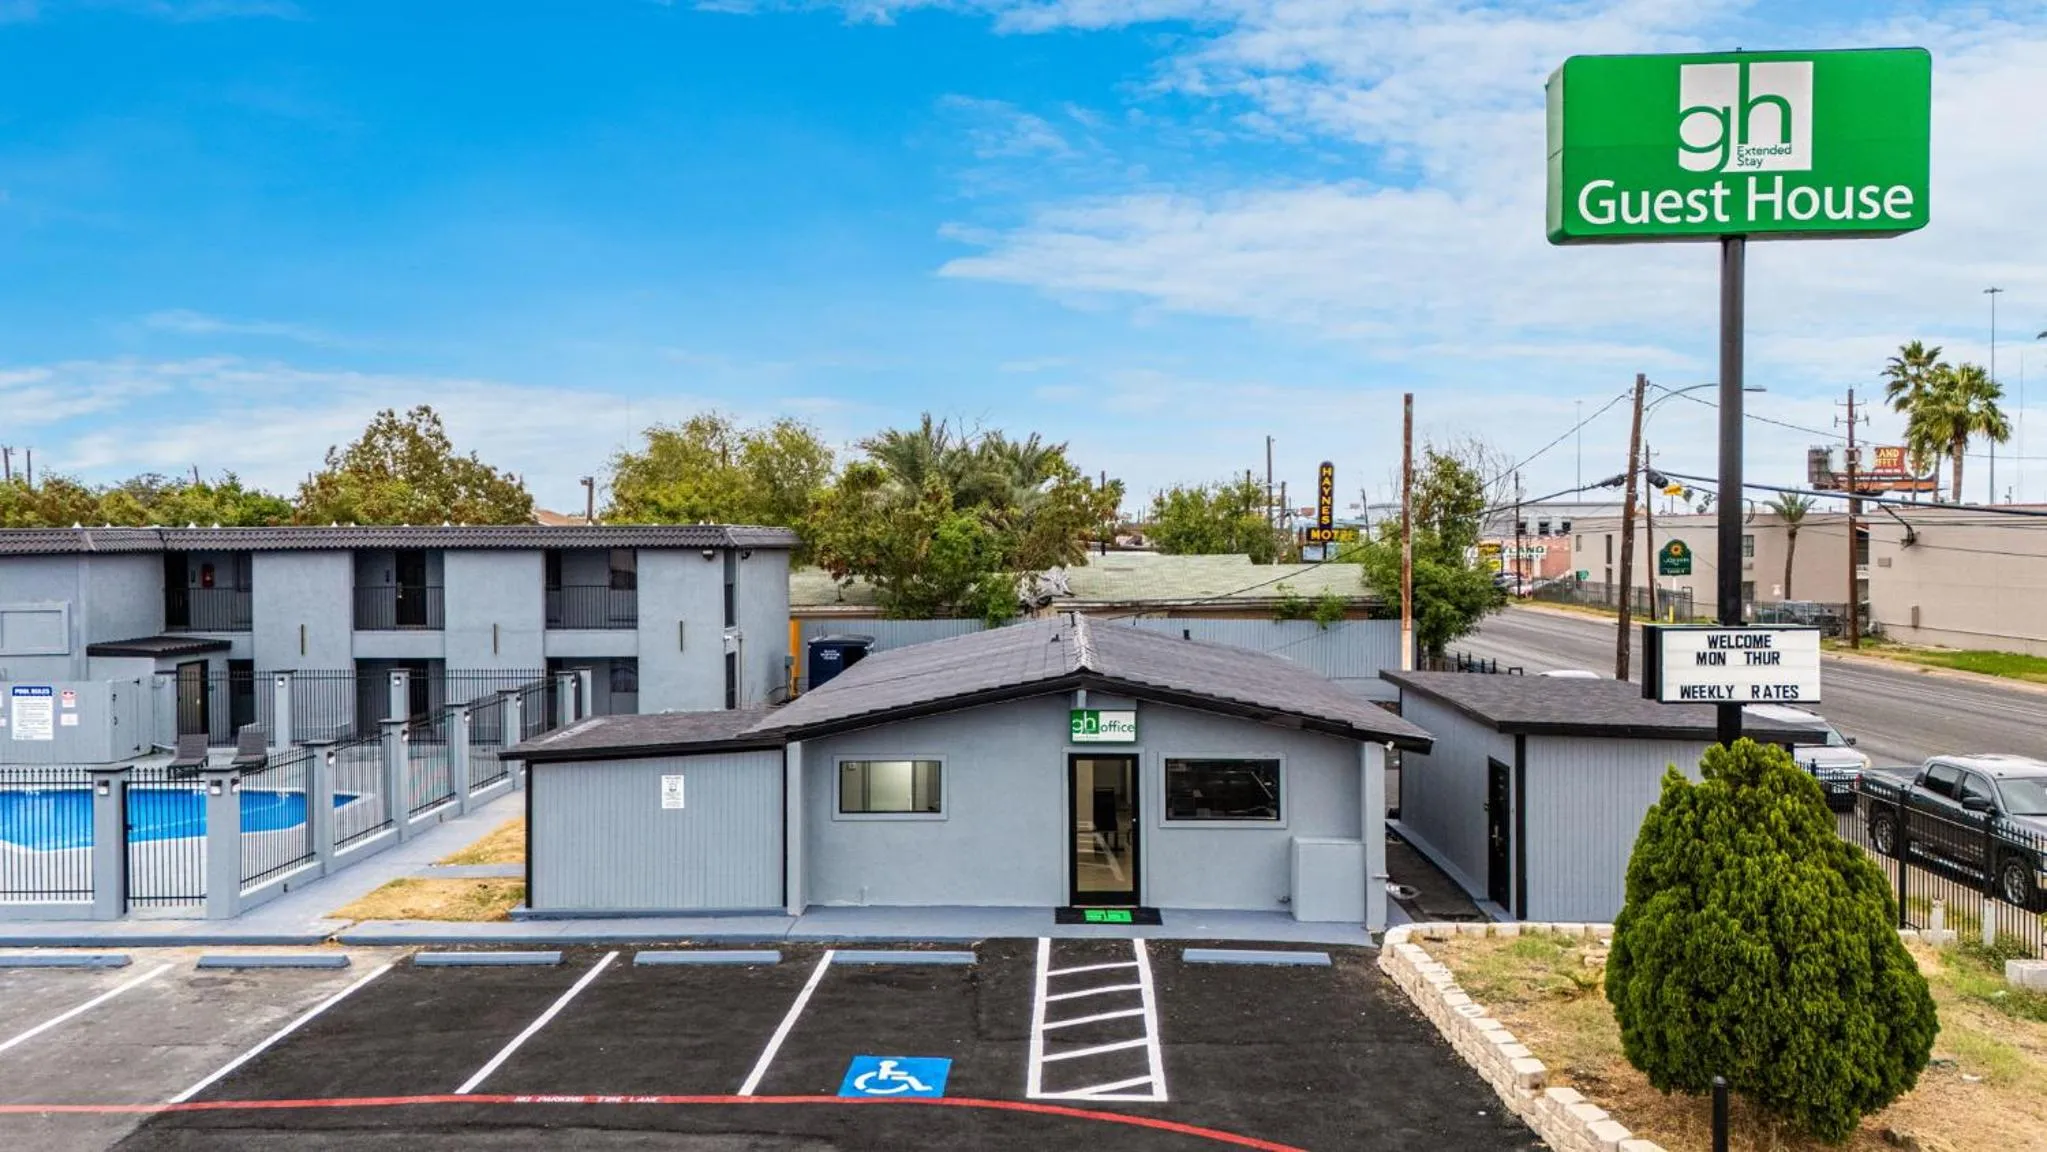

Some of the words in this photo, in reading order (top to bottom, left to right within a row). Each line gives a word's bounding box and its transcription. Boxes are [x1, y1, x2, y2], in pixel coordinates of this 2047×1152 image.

[1678, 62, 1792, 172] gh
[1737, 144, 1792, 156] Extended
[1737, 156, 1764, 169] Stay
[1578, 178, 1731, 225] Guest
[1747, 175, 1914, 222] House
[1321, 467, 1332, 525] HAYNES
[1707, 634, 1772, 649] WELCOME
[1696, 651, 1726, 666] MON
[1744, 651, 1781, 666] THUR
[1680, 684, 1735, 700] WEEKLY
[1751, 684, 1800, 700] RATES
[1100, 720, 1136, 733] office
